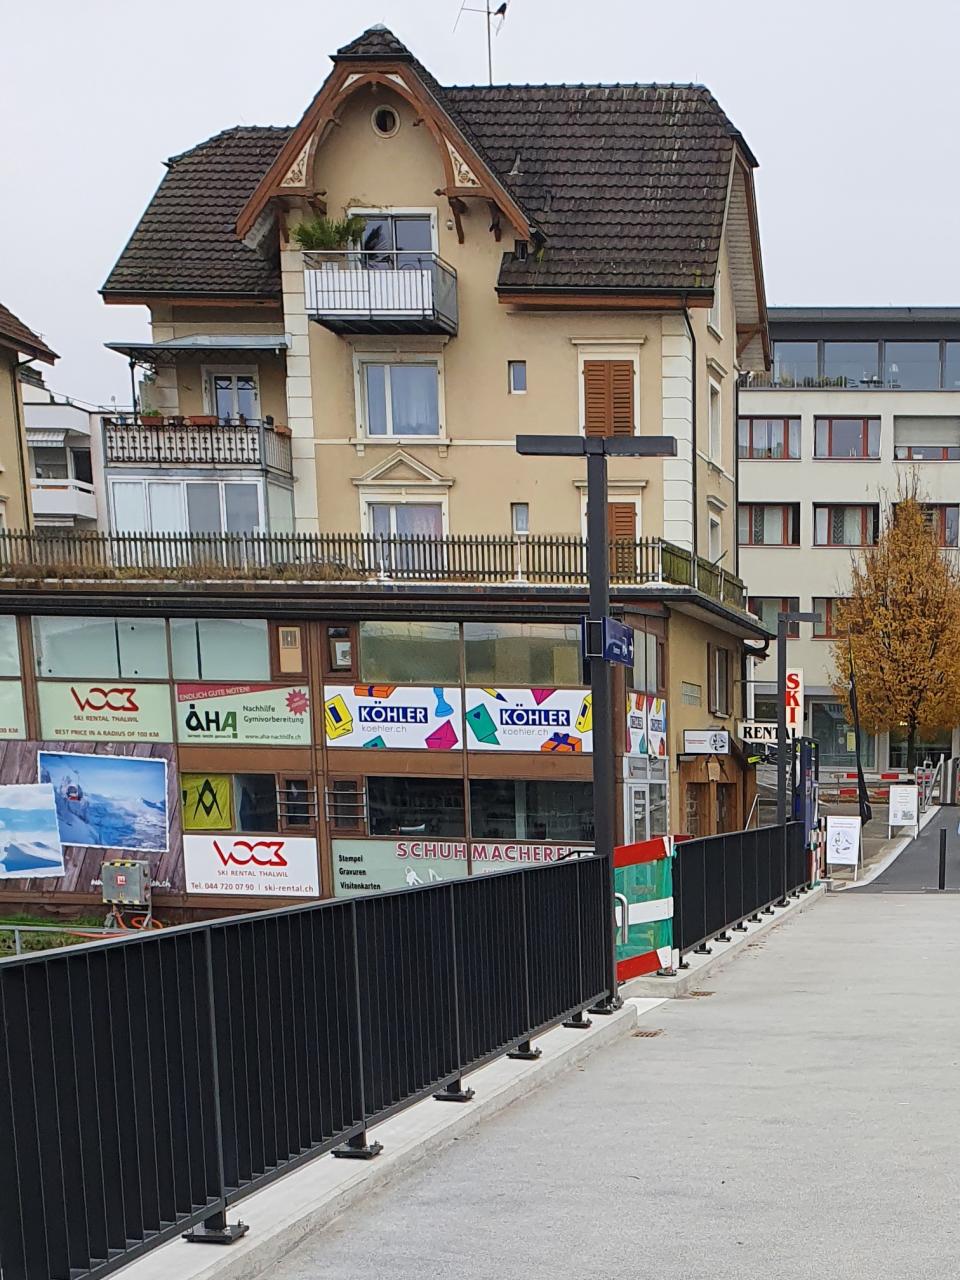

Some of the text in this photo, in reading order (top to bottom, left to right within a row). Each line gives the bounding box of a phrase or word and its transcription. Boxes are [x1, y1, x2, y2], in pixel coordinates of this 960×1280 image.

[208, 690, 225, 698] GUTE
[785, 673, 800, 723] SKI
[360, 701, 428, 723] KÖHLER
[501, 704, 570, 726] KÖHLER
[244, 716, 304, 724] Gymivorbereitung
[362, 724, 407, 732] koehler.ch
[503, 728, 549, 736] koehler.ch
[339, 867, 366, 876] Gravuren
[264, 885, 313, 893] ski-rental.ch
[340, 882, 380, 890] Visitenkarten
